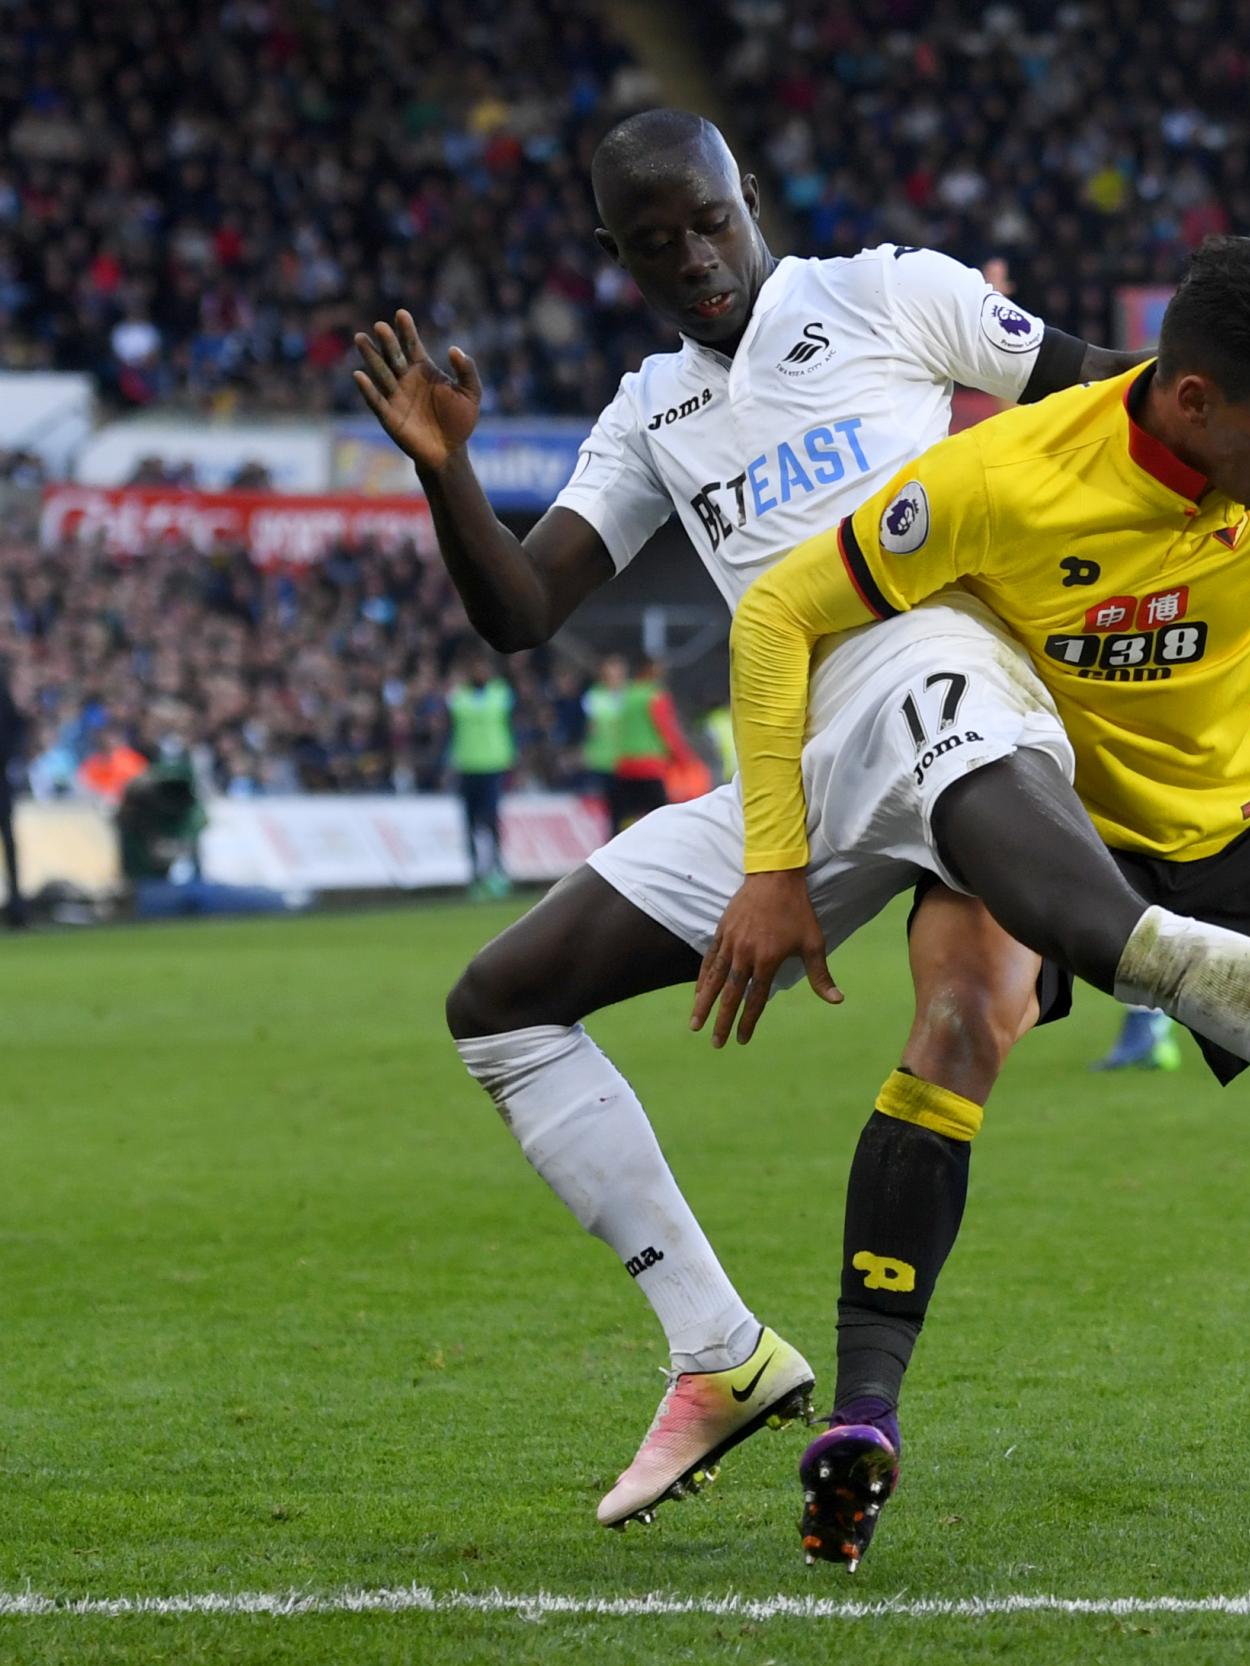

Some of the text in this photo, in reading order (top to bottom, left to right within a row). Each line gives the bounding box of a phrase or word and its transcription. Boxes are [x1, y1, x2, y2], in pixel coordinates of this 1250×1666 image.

[647, 387, 713, 431] Joma
[1054, 627, 1200, 667] 138
[899, 671, 969, 760] 17
[913, 730, 985, 787] Joma
[624, 1246, 665, 1279] ma
